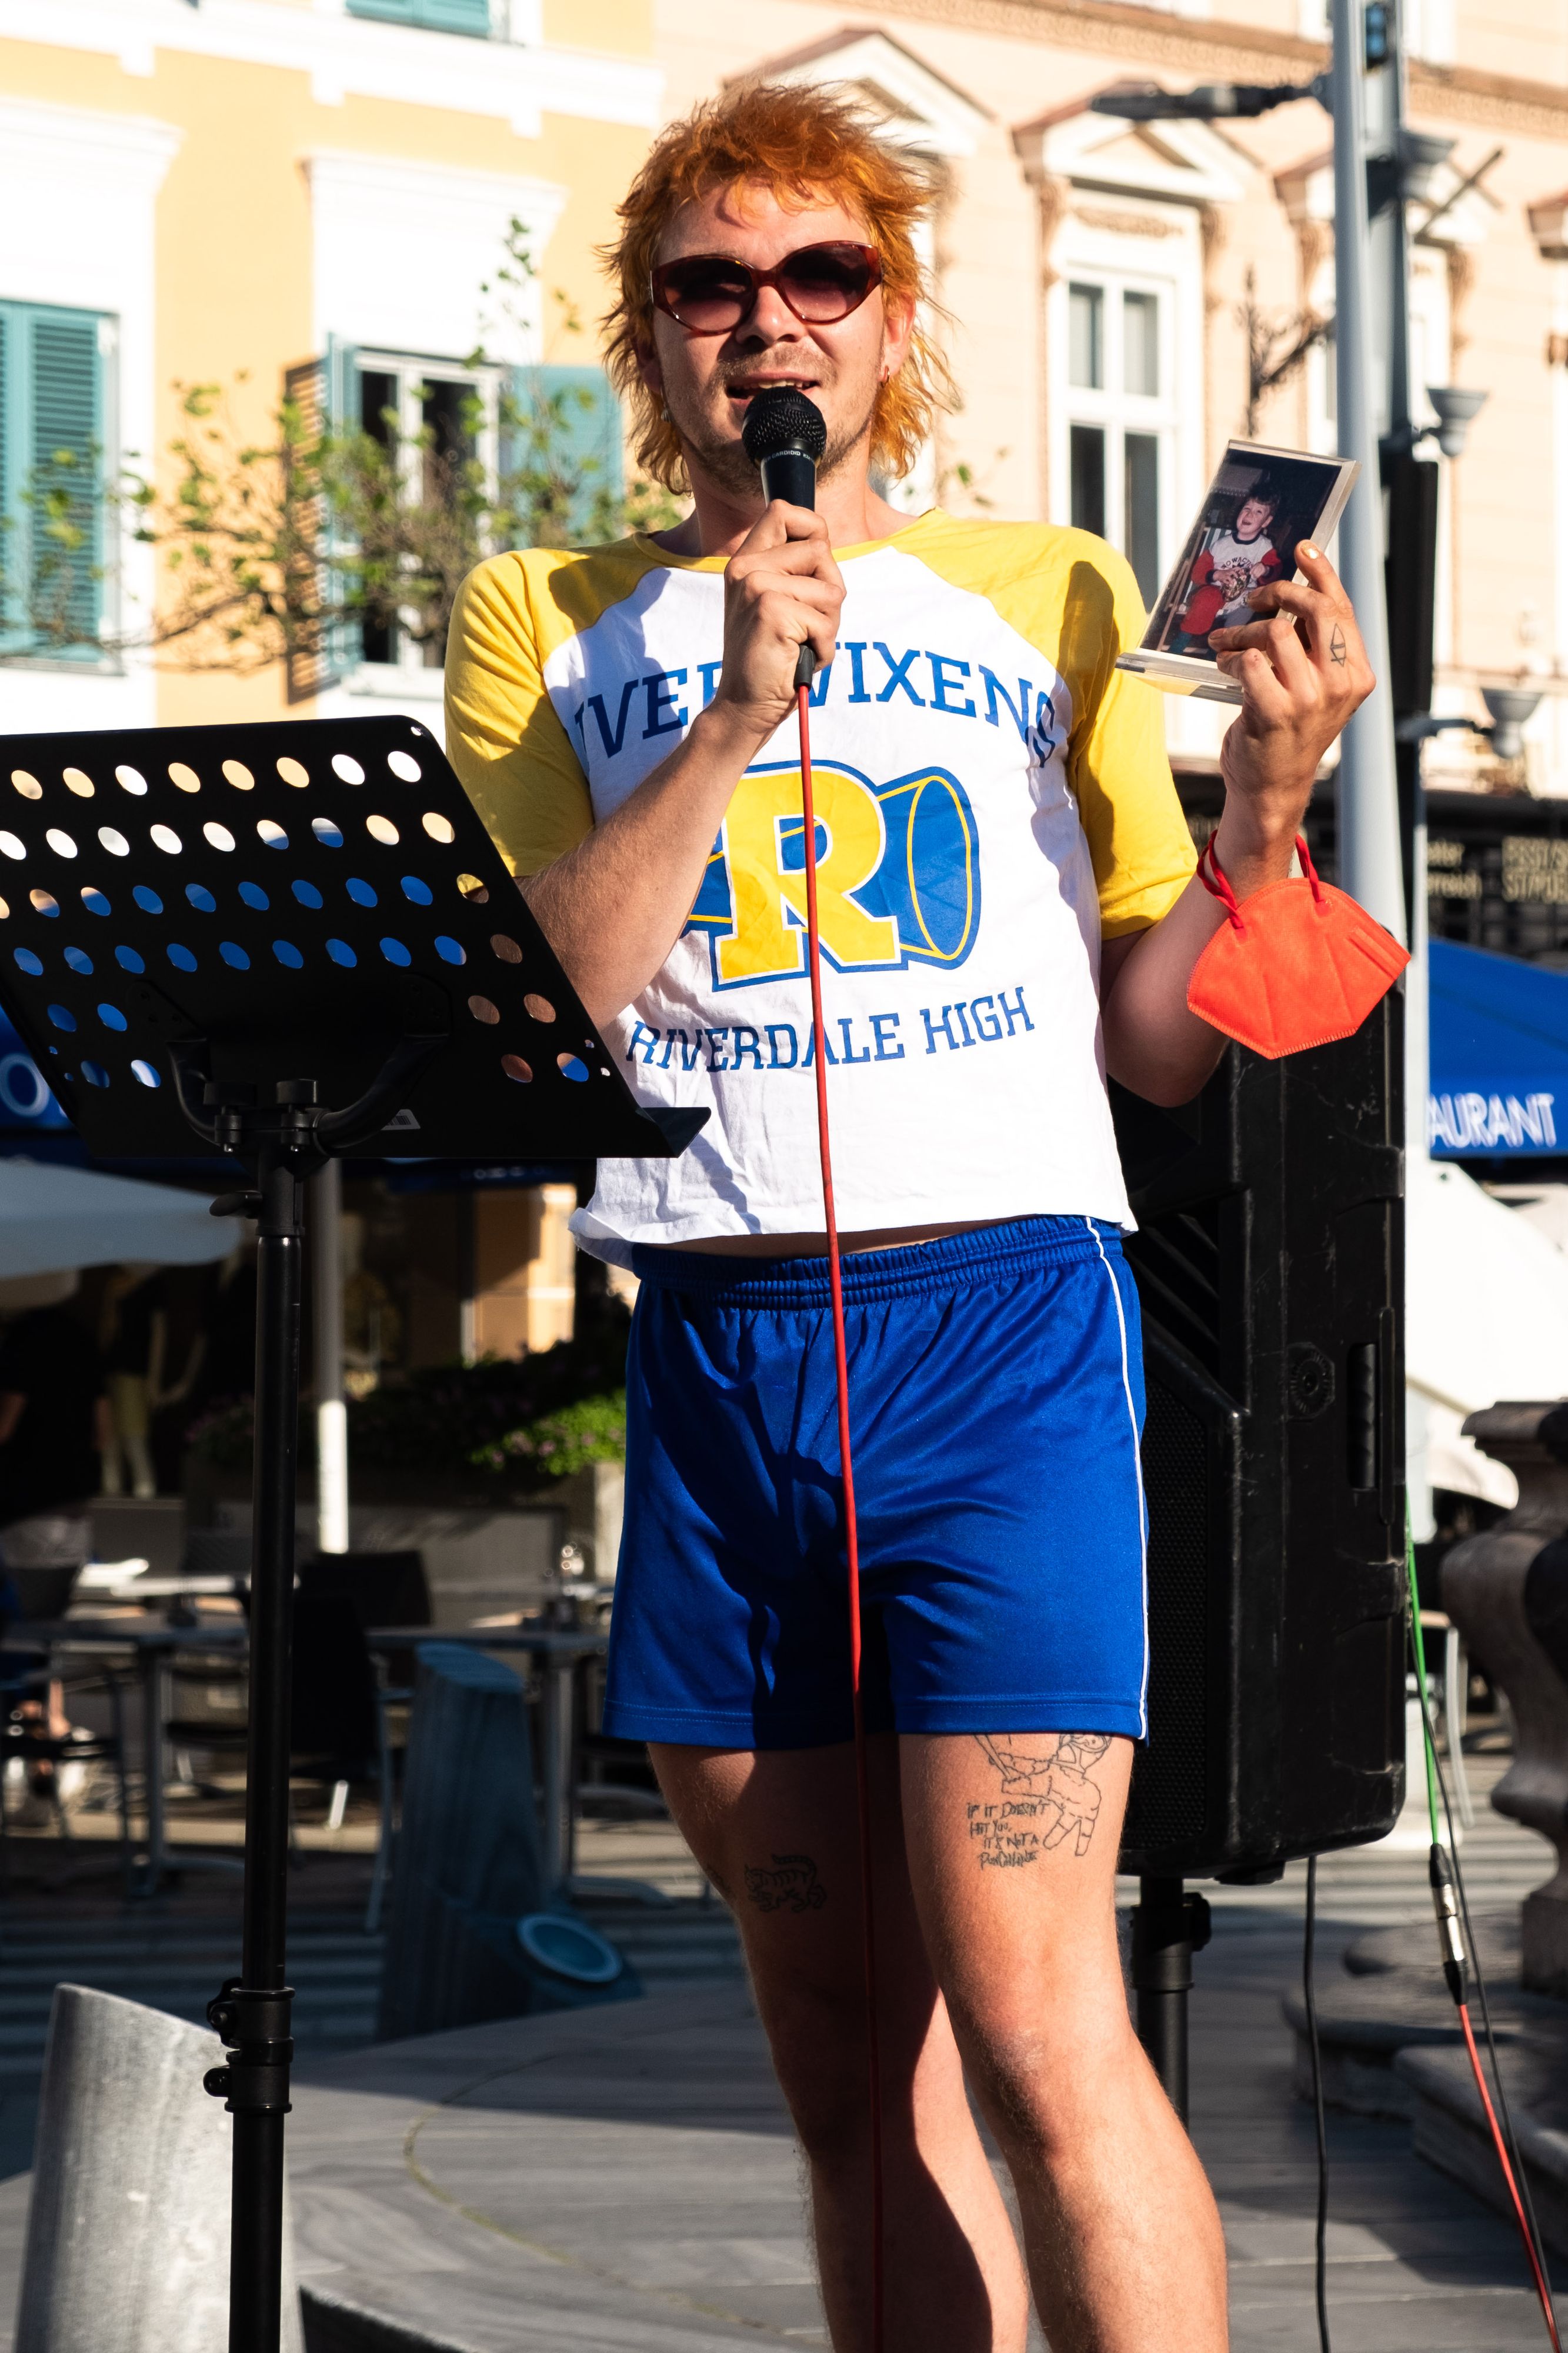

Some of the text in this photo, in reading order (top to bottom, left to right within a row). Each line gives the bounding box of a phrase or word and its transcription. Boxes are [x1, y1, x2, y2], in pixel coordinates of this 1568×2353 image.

[626, 986, 1035, 1073] RIVERDALE HIGH
[984, 1804, 998, 1818] IT
[1007, 1832, 1033, 1849] NOT
[1030, 1834, 1039, 1846] A
